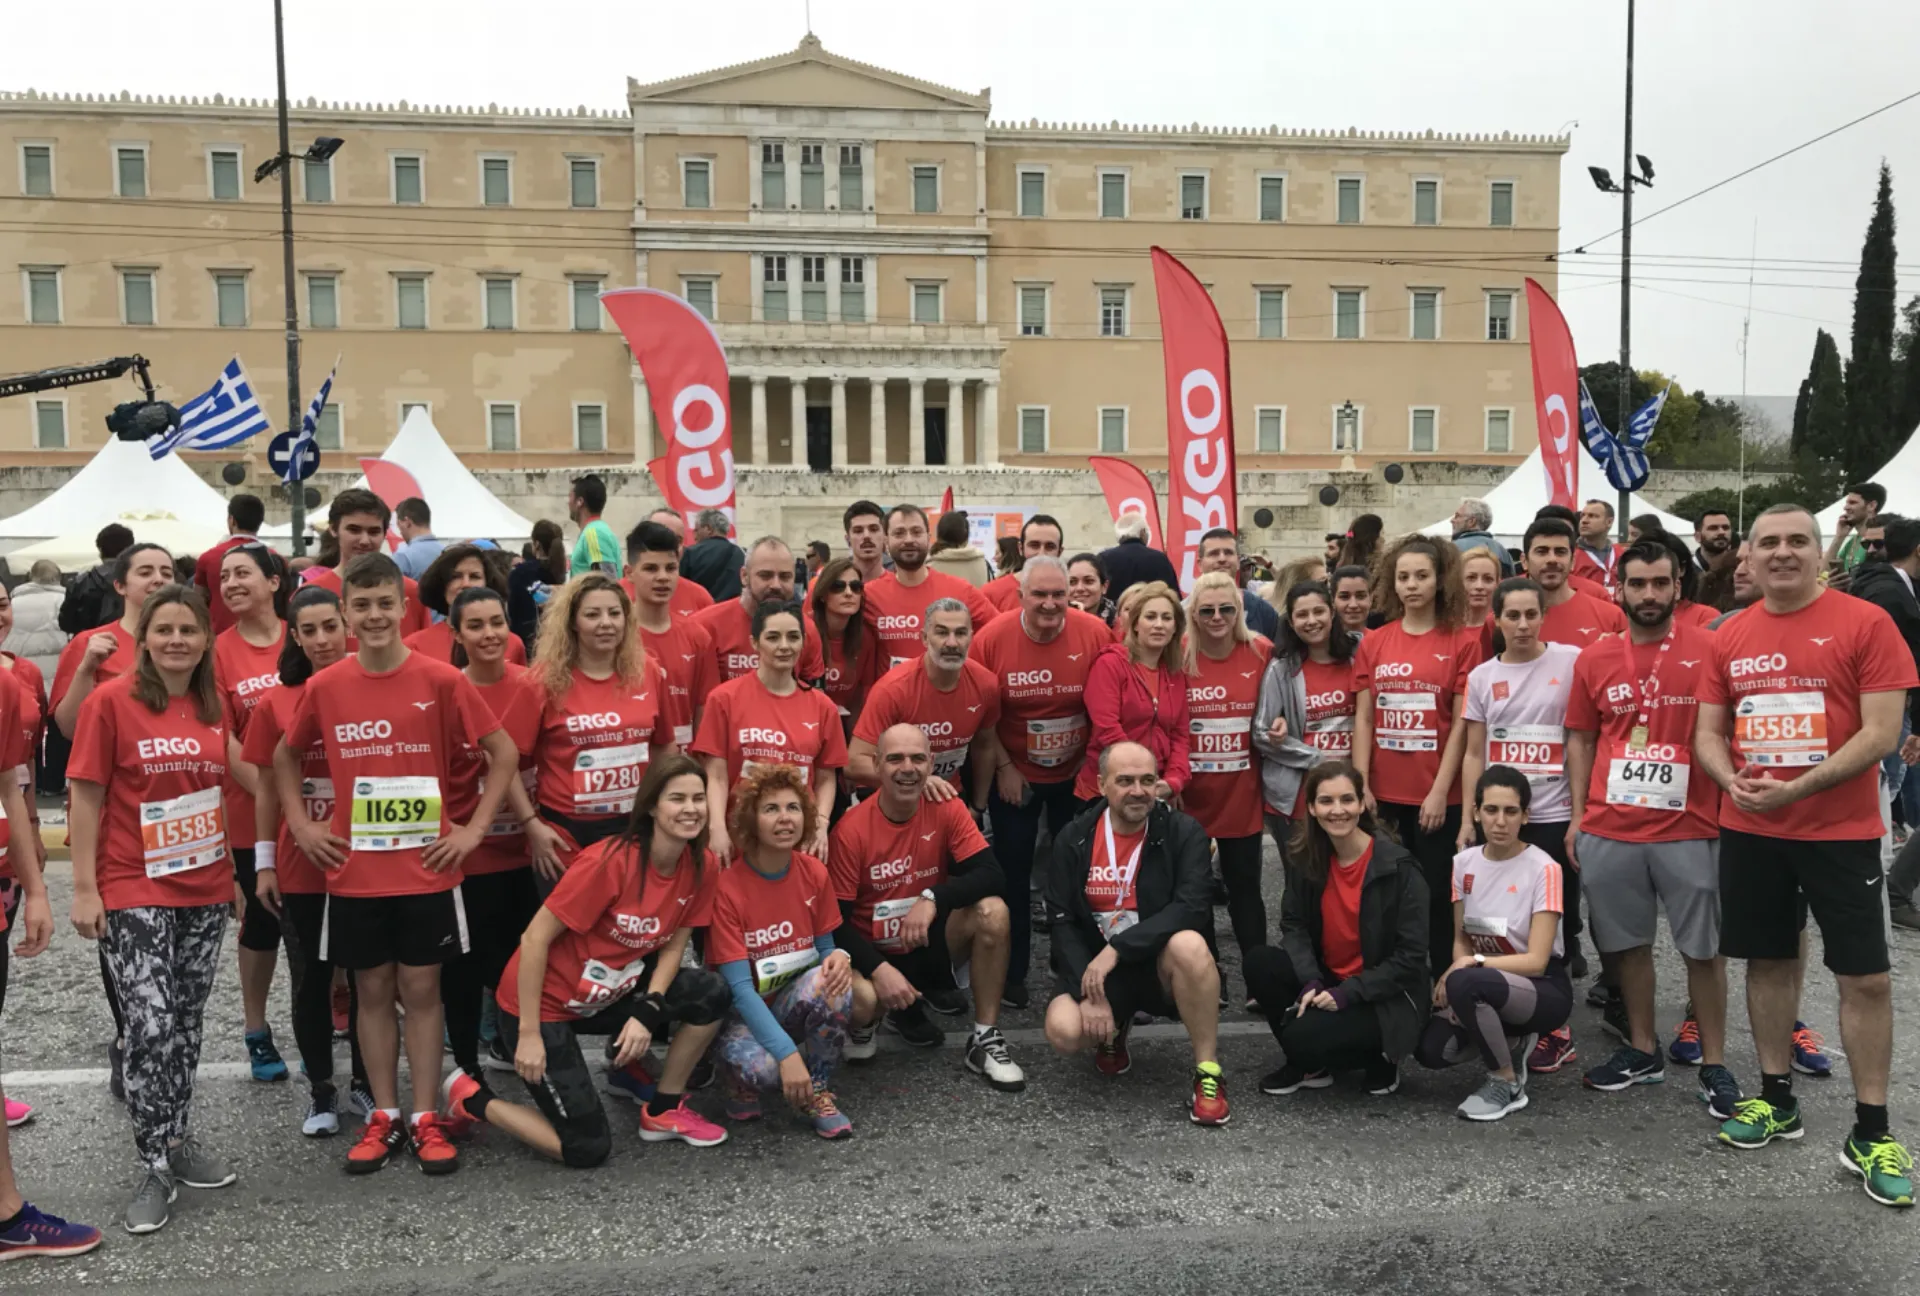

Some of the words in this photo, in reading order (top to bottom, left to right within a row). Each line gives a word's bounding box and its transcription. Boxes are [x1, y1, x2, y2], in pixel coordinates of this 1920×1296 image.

[877, 614, 920, 629] ERGO
[1375, 662, 1413, 679] ERGO
[1730, 652, 1788, 678] ERGO
[1007, 669, 1053, 687] ERGO
[1733, 675, 1788, 692] Running
[1789, 675, 1828, 688] Team
[1008, 686, 1053, 698] Running
[1055, 684, 1083, 693] Team
[1661, 694, 1697, 706] Team
[566, 711, 621, 732] ERGO
[917, 721, 953, 737] RGO
[1383, 710, 1426, 729] 19192
[1745, 714, 1814, 740] 15584
[335, 719, 393, 743] ERGO
[570, 731, 624, 746] Running
[738, 727, 787, 746] ERGO
[137, 737, 201, 759] ERGO
[340, 743, 393, 759] Running
[396, 741, 432, 753] Team
[1197, 734, 1242, 752] 19184
[742, 746, 785, 762] Running
[787, 751, 814, 763] Team
[1501, 742, 1551, 764] 19190
[143, 759, 201, 776] Running
[1622, 761, 1673, 785] 6478
[584, 765, 640, 793] 19280
[366, 799, 428, 823] 11639
[155, 811, 217, 848] 15585
[870, 855, 913, 880] ERGO
[616, 913, 661, 934] ERGO
[744, 920, 794, 949] ERGO
